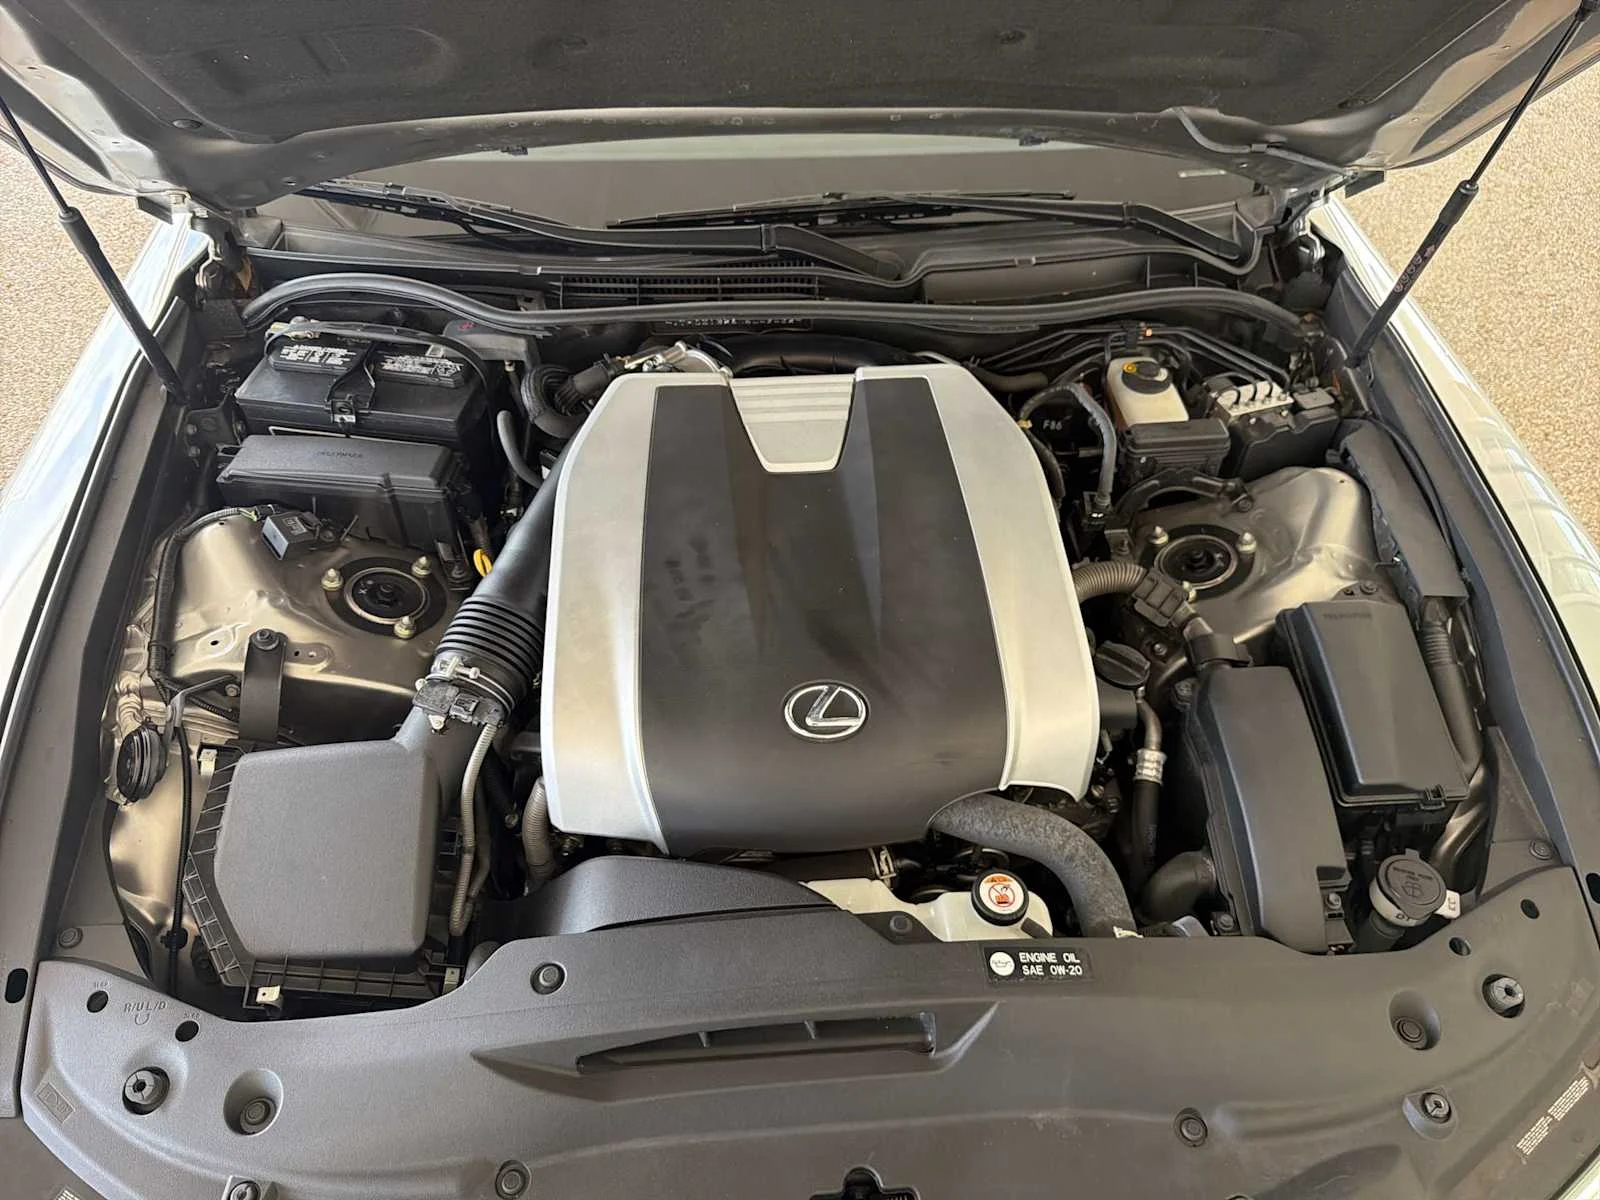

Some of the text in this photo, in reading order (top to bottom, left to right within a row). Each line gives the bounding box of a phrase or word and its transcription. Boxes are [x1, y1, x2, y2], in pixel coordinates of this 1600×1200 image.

[1018, 952, 1080, 963] ENGINE OIL
[1022, 965, 1083, 976] SAE 0W-20
